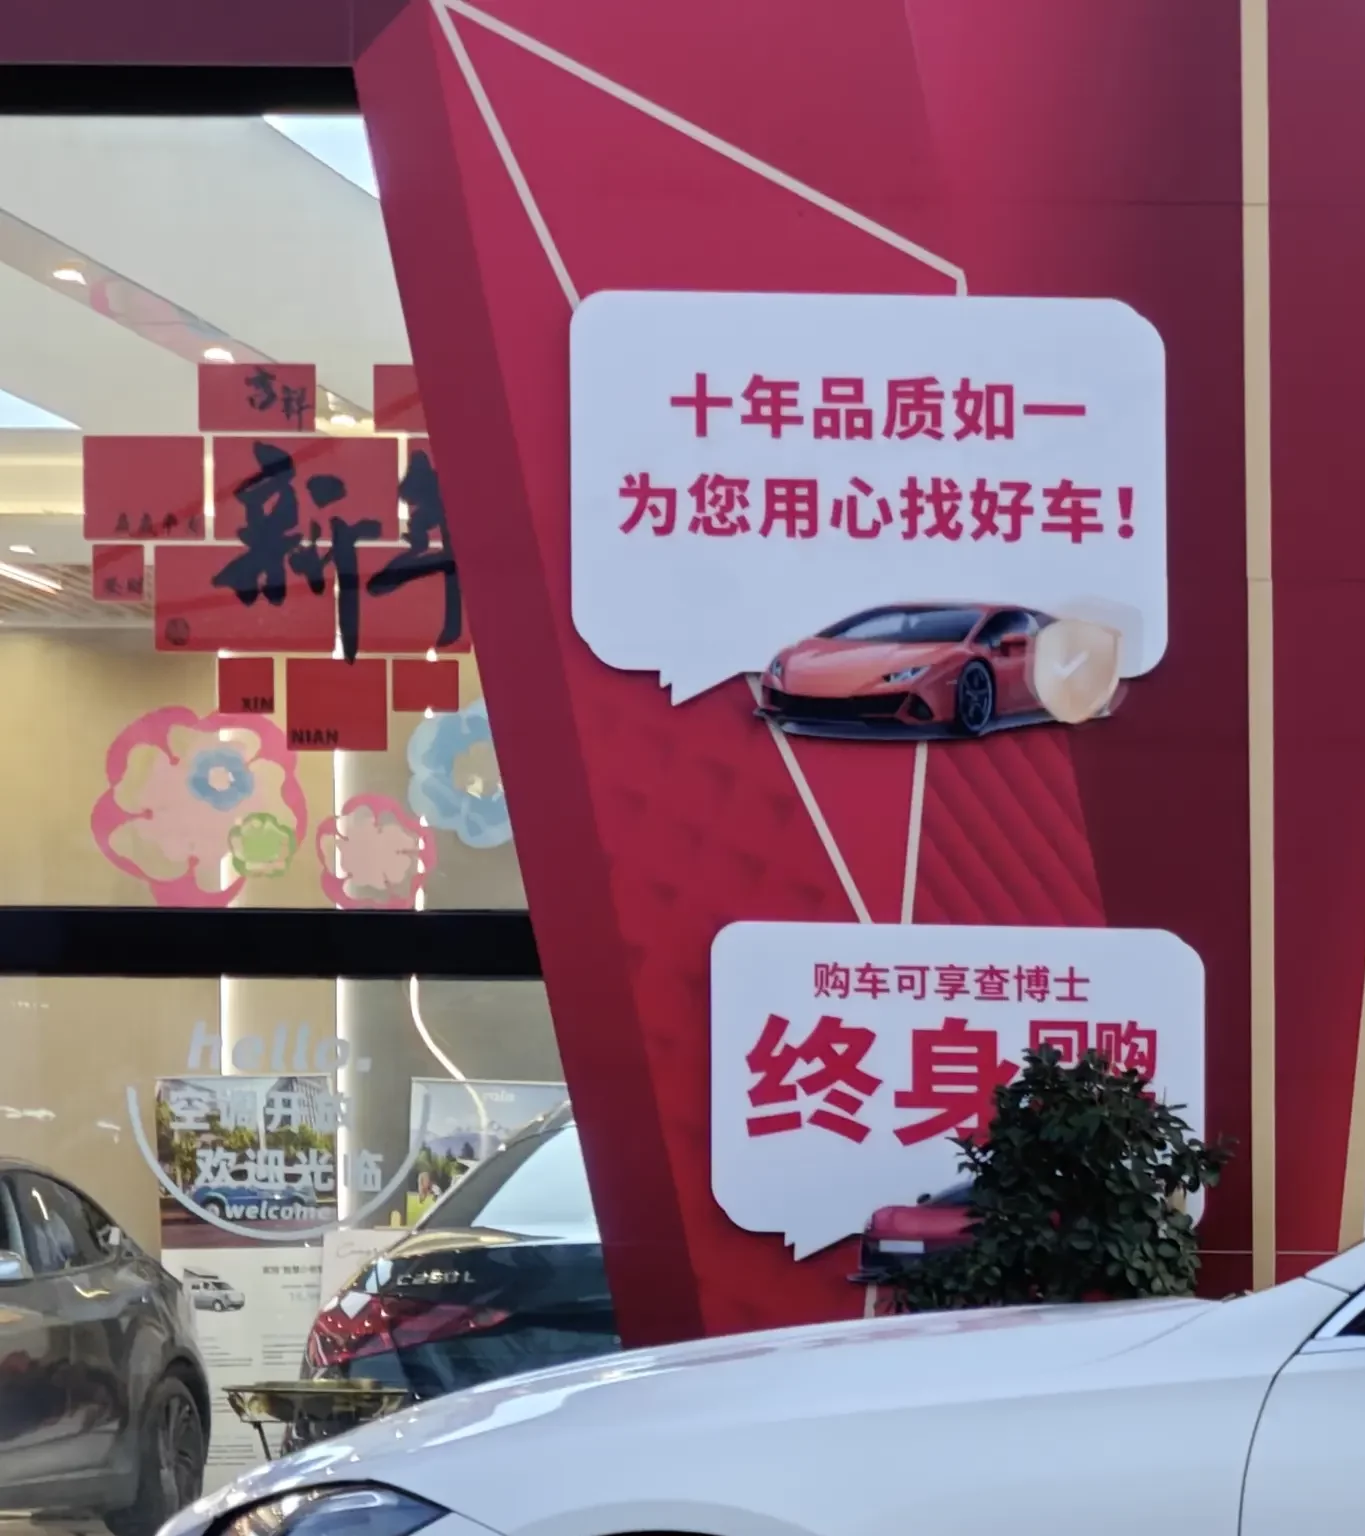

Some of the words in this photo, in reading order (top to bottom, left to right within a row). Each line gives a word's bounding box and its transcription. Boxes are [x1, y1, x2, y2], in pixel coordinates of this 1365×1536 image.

[669, 371, 1087, 442] 十年品质如一
[617, 472, 1136, 544] 为您用心找好车！
[240, 695, 275, 712] XIN
[290, 728, 340, 746] NIAN
[813, 962, 1091, 1003] 购车可享查博士
[194, 1148, 384, 1193] 欢迎光临
